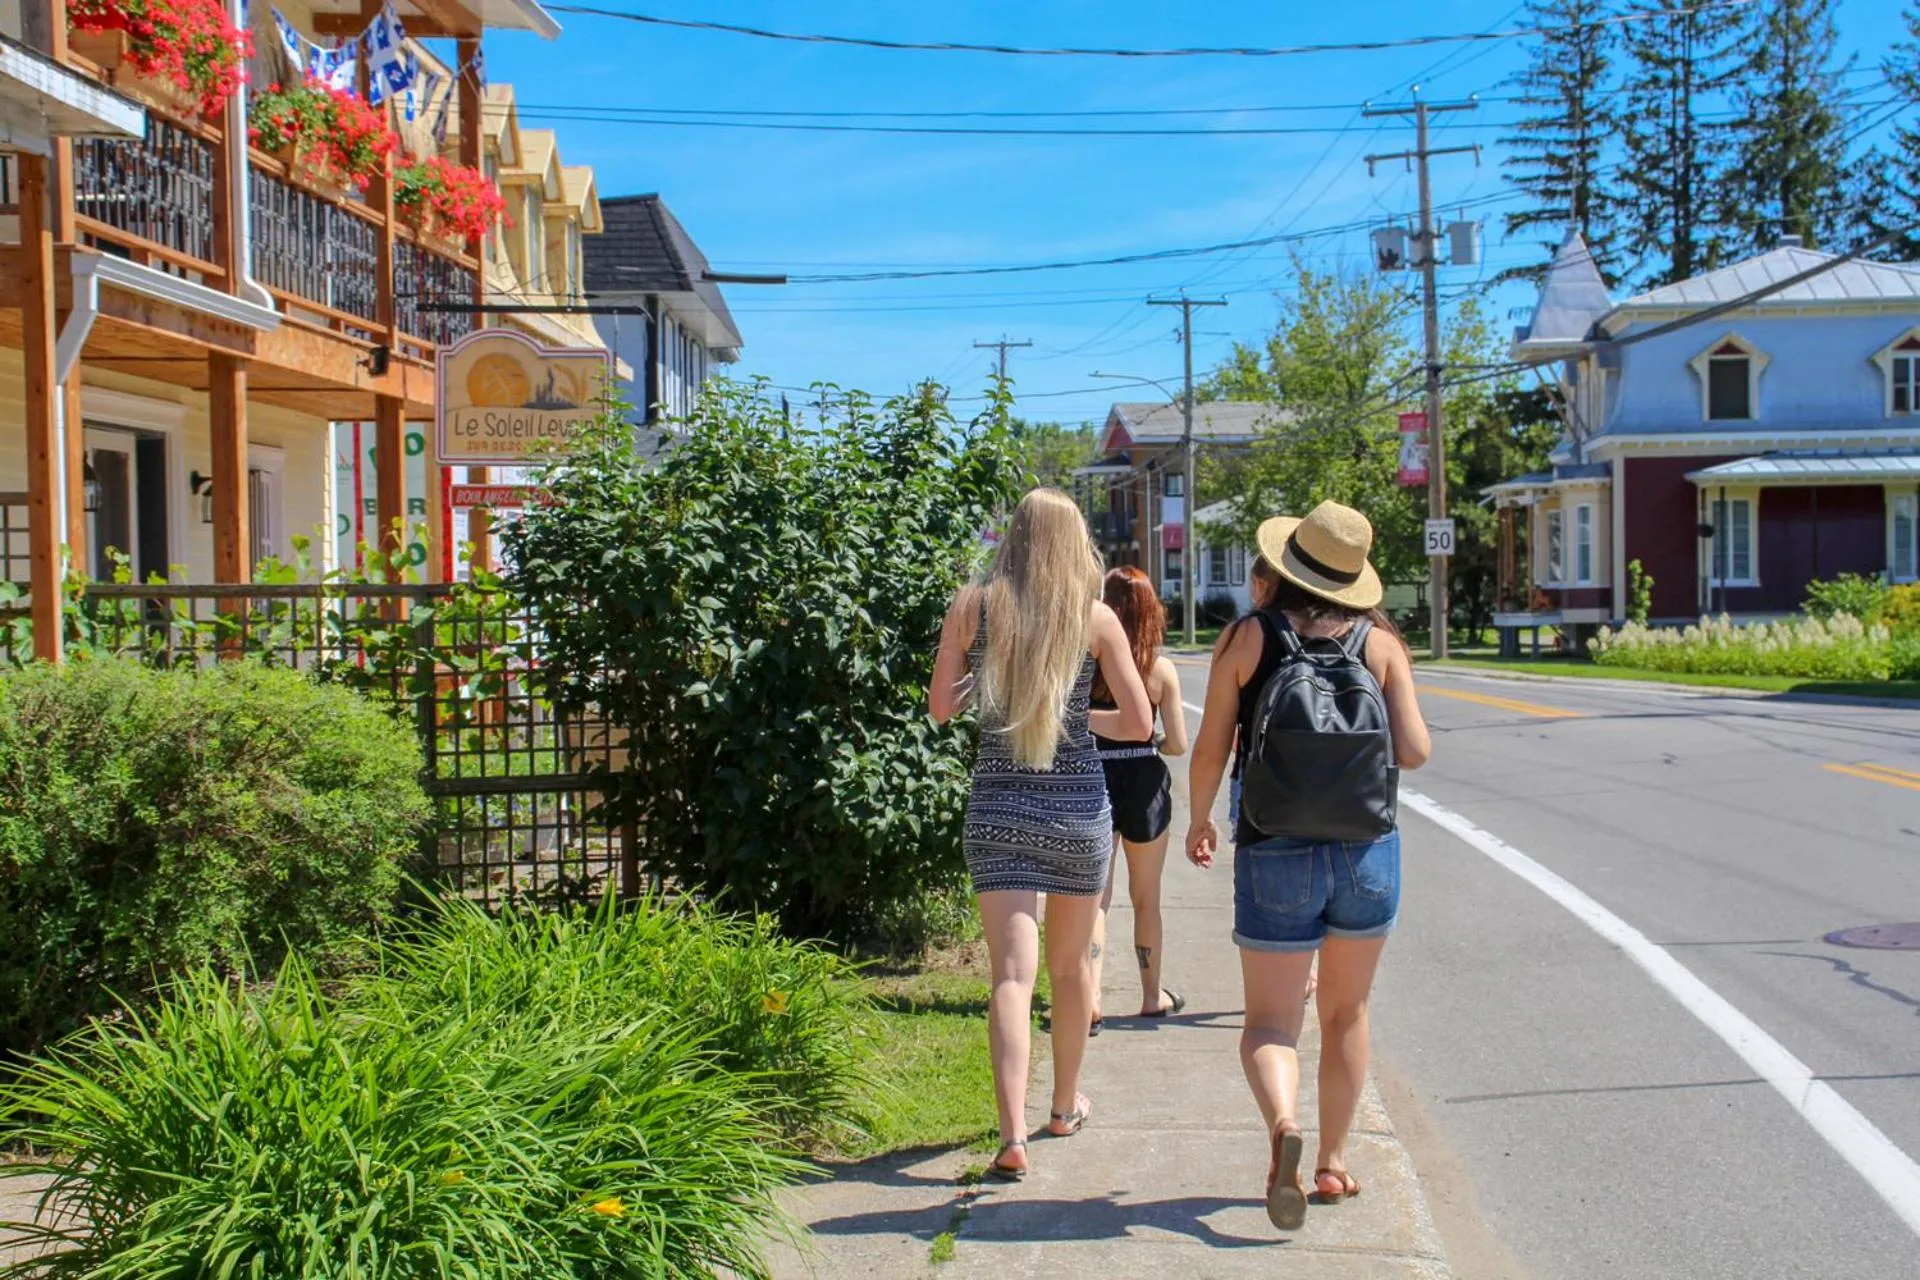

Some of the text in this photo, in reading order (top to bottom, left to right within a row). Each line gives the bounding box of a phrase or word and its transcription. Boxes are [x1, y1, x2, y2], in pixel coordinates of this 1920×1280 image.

[454, 412, 595, 438] Le Soleil Levan
[1428, 531, 1451, 550] 50
